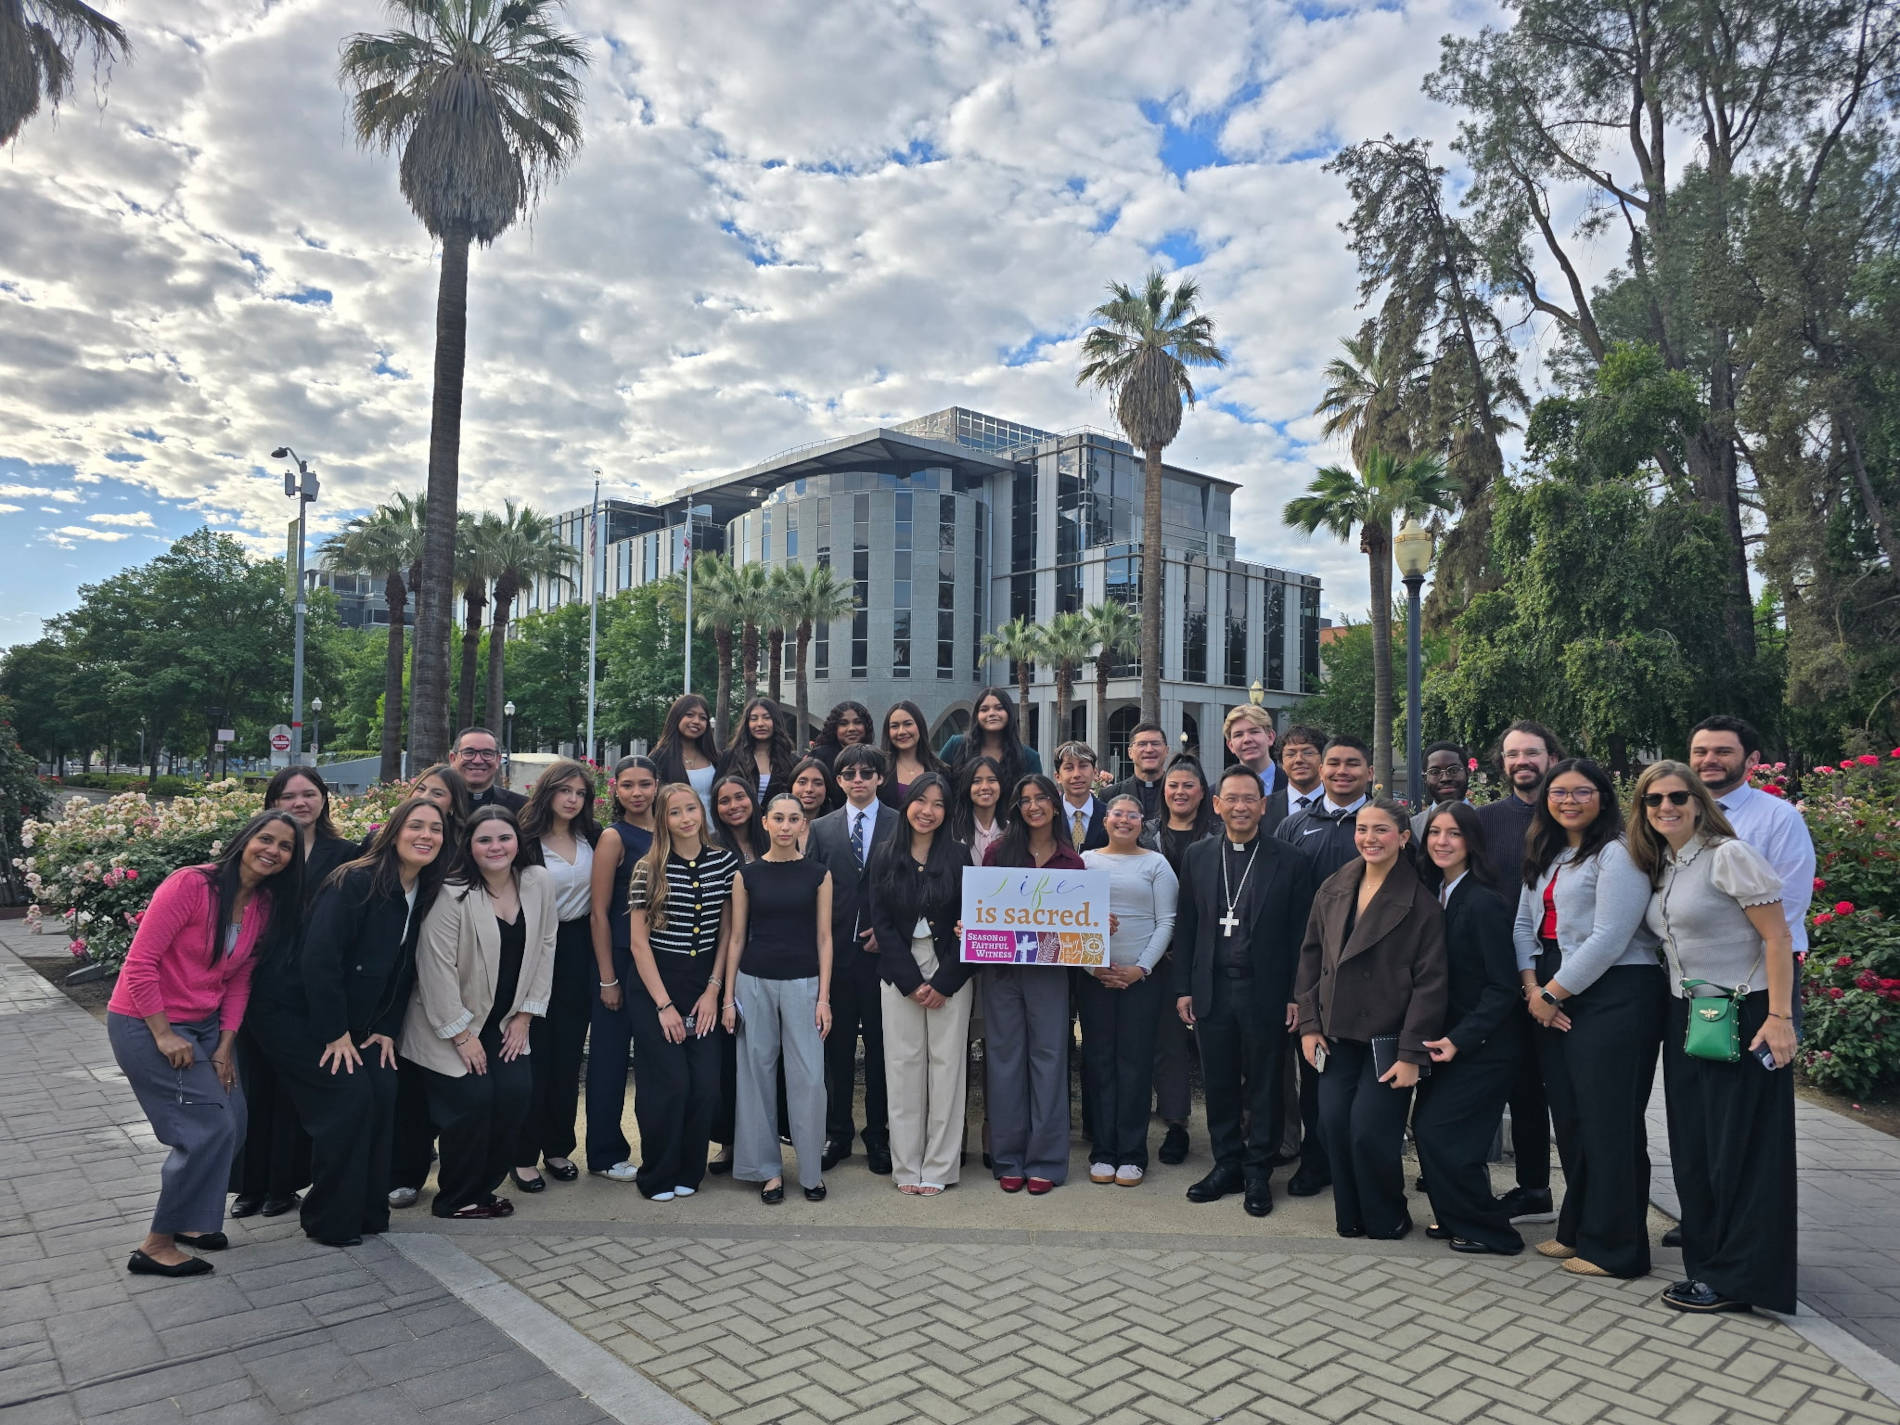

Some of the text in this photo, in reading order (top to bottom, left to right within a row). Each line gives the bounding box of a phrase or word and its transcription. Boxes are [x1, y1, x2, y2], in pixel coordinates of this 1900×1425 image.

[976, 899, 1100, 927] is sacred.
[967, 933, 998, 941] SEASON
[971, 941, 1009, 949] FAITHFUL
[976, 950, 1012, 958] WITNESS
